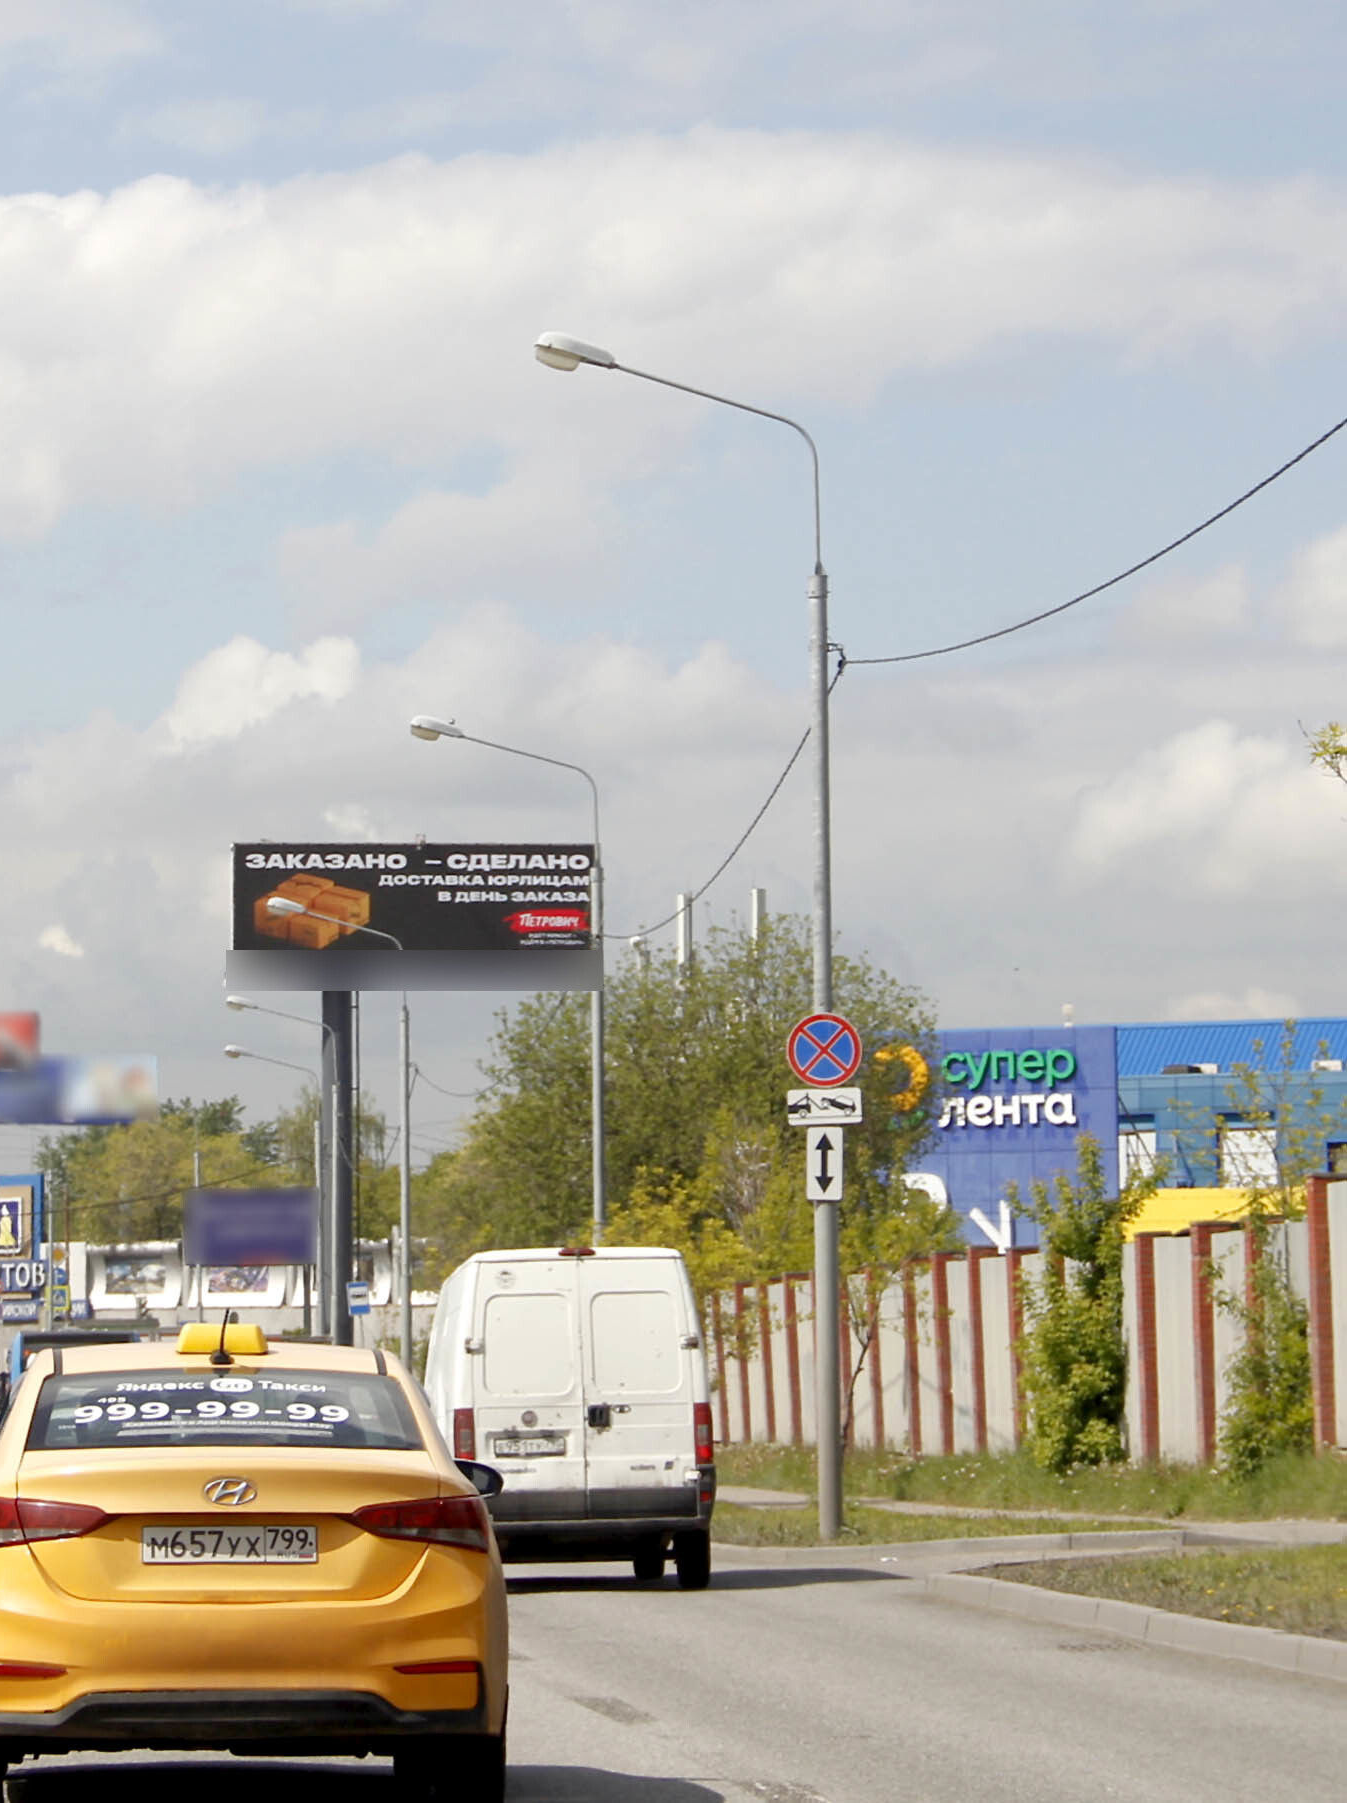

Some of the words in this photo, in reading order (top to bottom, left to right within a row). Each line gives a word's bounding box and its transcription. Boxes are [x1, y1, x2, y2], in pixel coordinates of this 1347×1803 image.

[245, 853, 407, 869] ЗАКАЗАНО
[447, 853, 590, 871] СДЕЛАНО
[378, 874, 485, 887] ДОСТАВКА
[488, 874, 589, 887] ЮРЛИЦАМ
[438, 891, 452, 902] В
[454, 891, 508, 903] ДЕНЬ
[511, 891, 590, 902] ЗАКАЗА
[942, 1048, 1076, 1090] супер
[938, 1092, 1077, 1128] лента
[116, 1381, 204, 1392] Яндекс
[258, 1380, 327, 1392] Такси
[74, 1401, 349, 1423] 999-99-99
[150, 1530, 261, 1558] М657УХ
[267, 1529, 309, 1550] 799
